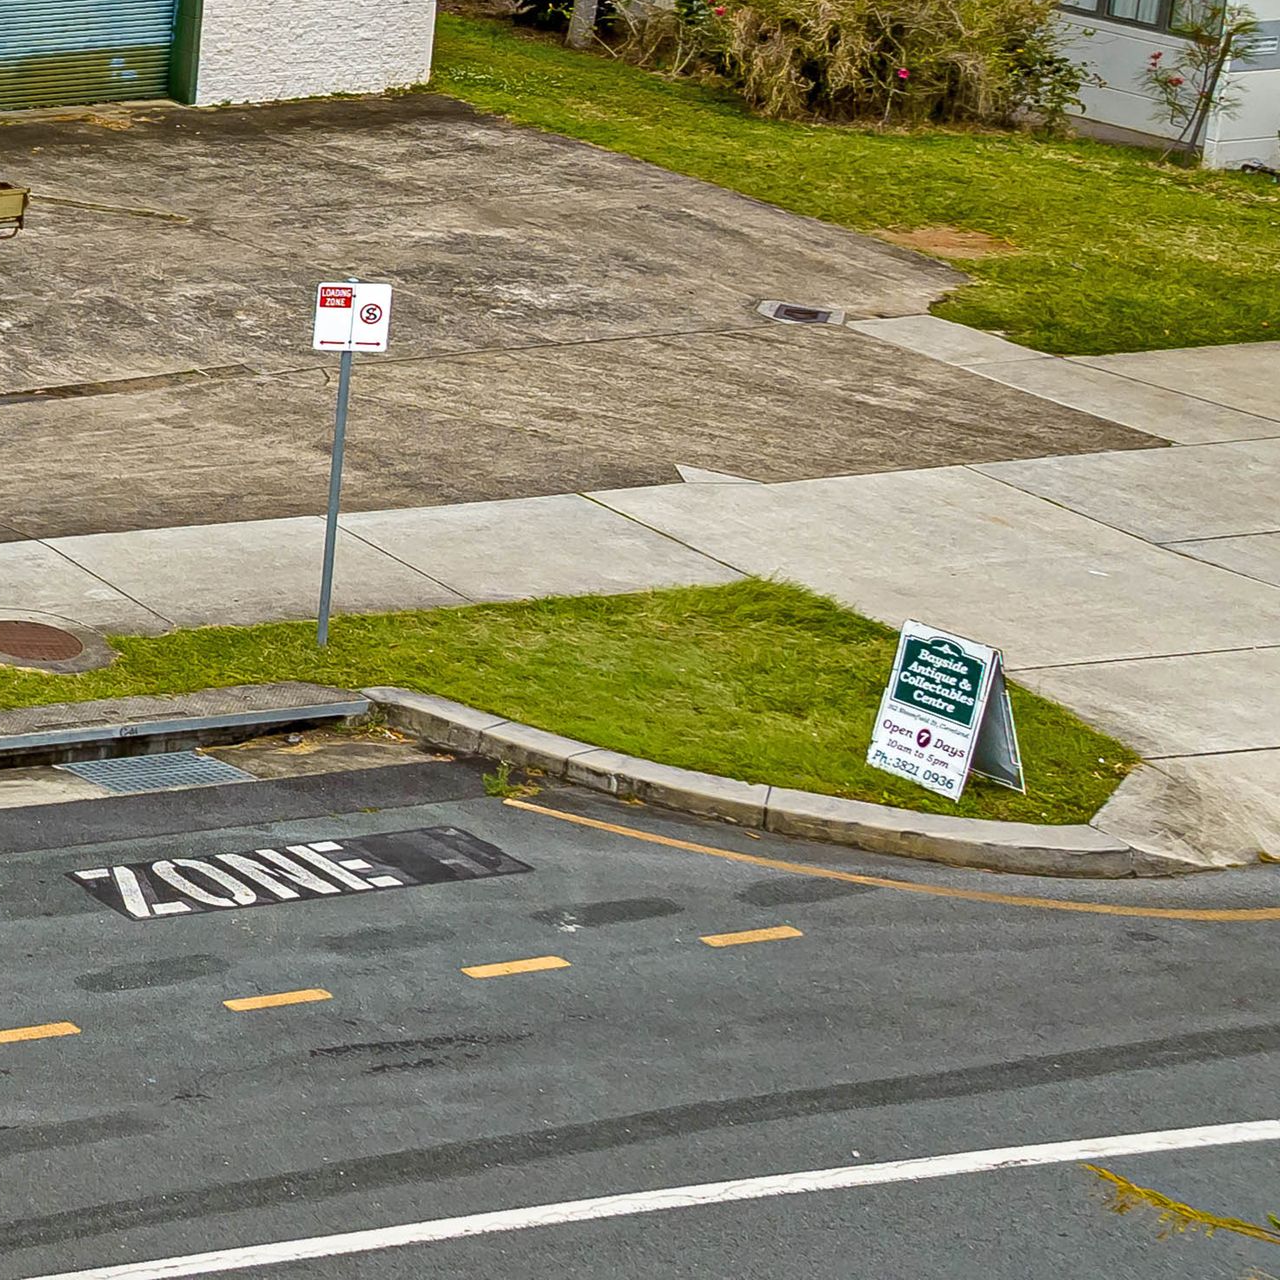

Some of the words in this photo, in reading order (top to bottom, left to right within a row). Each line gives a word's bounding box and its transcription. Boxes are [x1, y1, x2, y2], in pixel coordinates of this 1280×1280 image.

[321, 288, 352, 298] LOADING
[325, 298, 347, 307] ZONE
[907, 661, 958, 686] Antique
[958, 678, 972, 691] &
[917, 648, 969, 675] Bayside
[900, 671, 975, 706] Collectables
[913, 690, 956, 713] Centre
[882, 719, 914, 738] Open
[919, 732, 930, 744] 7
[933, 738, 966, 758] Days
[886, 738, 913, 754] 10am
[914, 749, 925, 759] to
[926, 754, 949, 769] 5pm
[892, 757, 920, 776] 3821
[922, 769, 955, 790] 0936
[74, 840, 404, 919] ZONE
